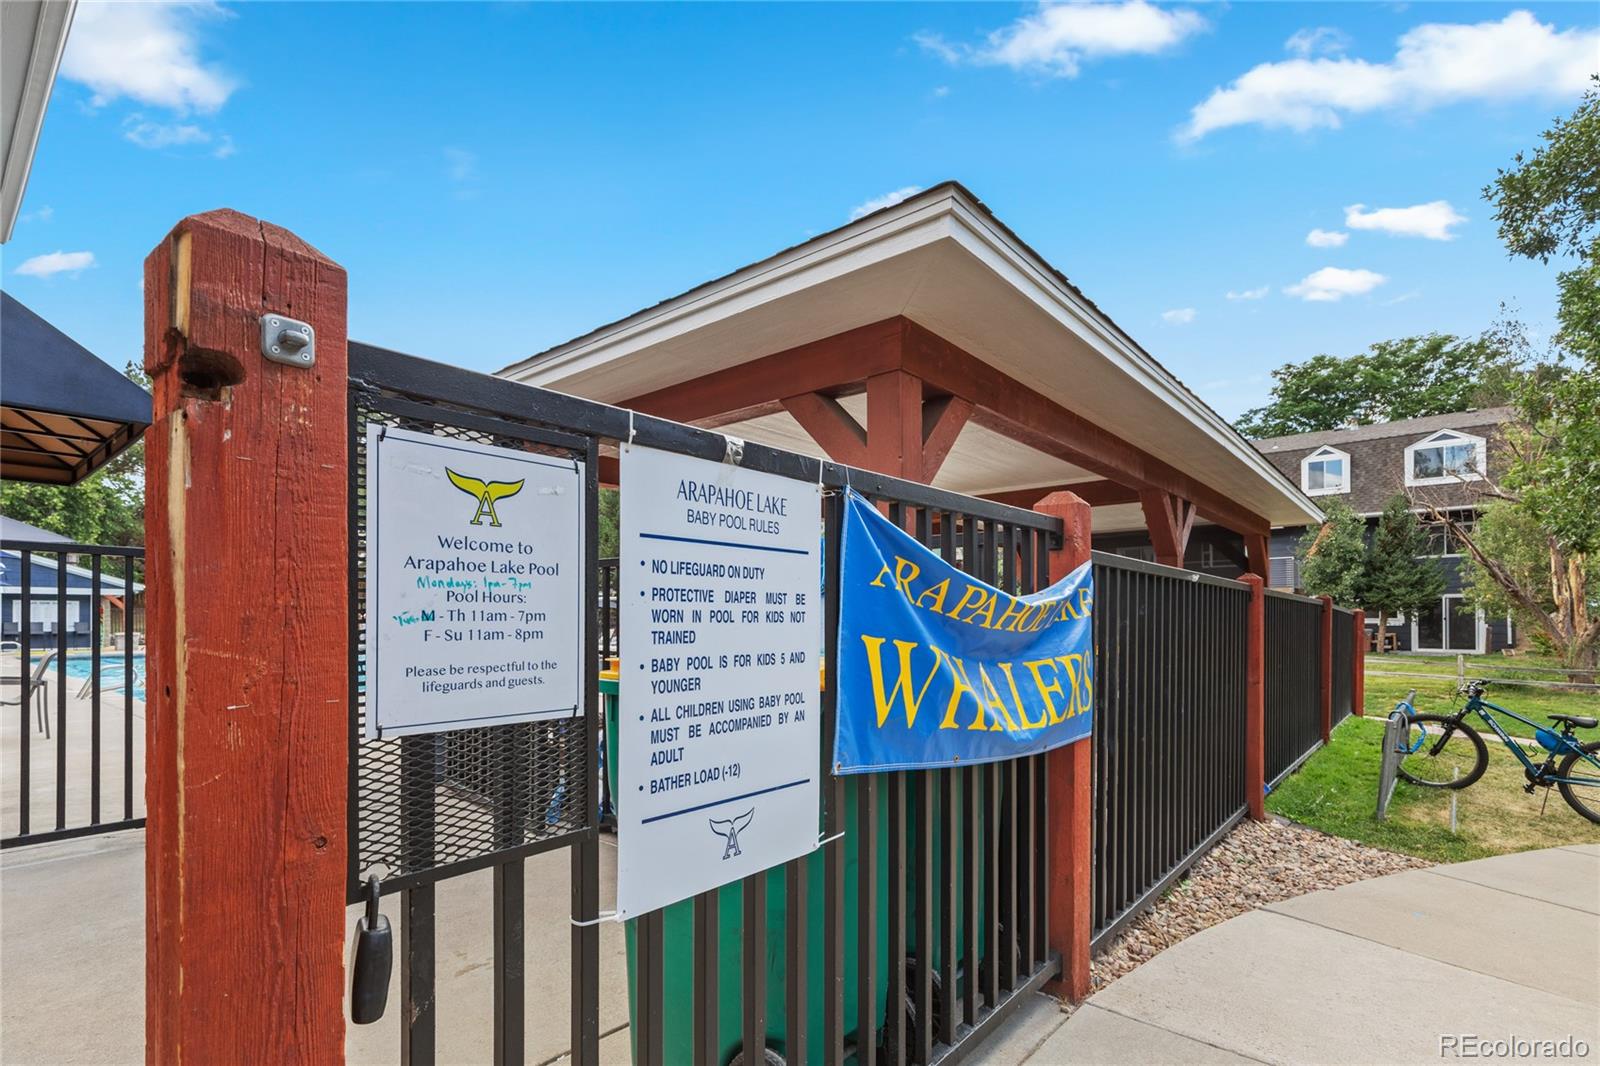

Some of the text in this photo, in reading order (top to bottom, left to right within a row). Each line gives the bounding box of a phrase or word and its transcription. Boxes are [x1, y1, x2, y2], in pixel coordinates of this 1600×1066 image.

[677, 480, 787, 517] ARAPAHOE LAKE
[687, 509, 780, 534] BABY POOL RULES
[438, 536, 533, 554] Welcome to
[404, 556, 559, 576] Arapahoe Lake Pool
[652, 560, 765, 580] NO LIFEGUARD ON DUTY
[446, 590, 527, 604] Pool Hours:
[652, 588, 805, 605] PROTECTIVE DIAPER MUST BE
[446, 610, 466, 622] Th
[472, 610, 506, 622] 11am
[518, 610, 546, 624] 7pm
[652, 610, 805, 623] WORN IN POOL FOR KIDS NOT
[424, 630, 432, 642] F
[444, 629, 462, 642] Su
[468, 629, 504, 641] 11am
[516, 628, 544, 642] 8pm
[652, 631, 696, 645] TRAINED
[406, 660, 558, 678] Please be respectful to the
[651, 652, 805, 672] BABY POOL IS FOR KIDS 5 AND
[422, 675, 545, 694] lifeguards and guests.
[651, 677, 701, 694] YOUNGER
[861, 634, 1092, 732] WHALERS
[651, 692, 805, 722] ALL CHILDREN USING BABY POOL
[651, 710, 805, 744] MUST BE ACCOMPANIED BY AN
[651, 747, 684, 766] ADULT
[651, 763, 741, 794] BATHER LOAD (-12)
